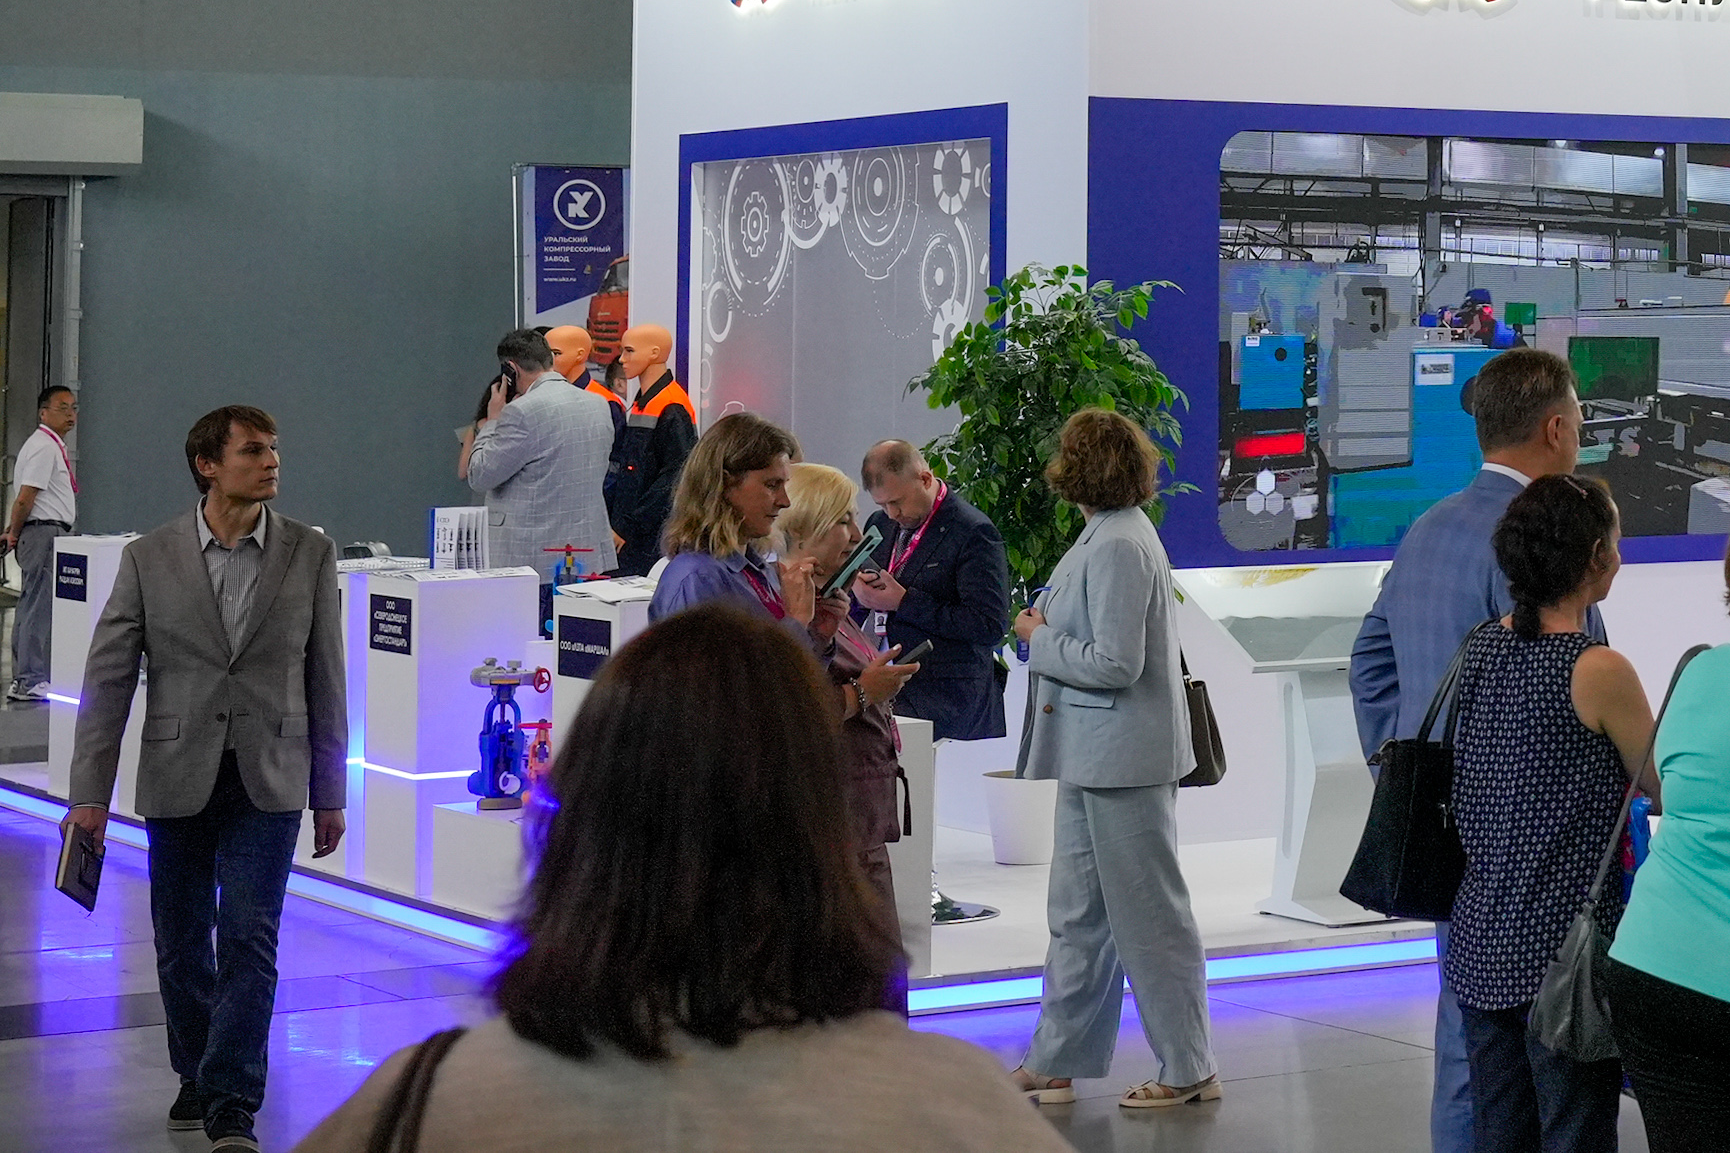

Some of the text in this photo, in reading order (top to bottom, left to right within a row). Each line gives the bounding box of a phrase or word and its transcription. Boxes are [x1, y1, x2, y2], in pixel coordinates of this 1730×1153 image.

[543, 235, 588, 243] УРАЛЬСКИЙ
[543, 245, 611, 253] КОМПРЕССОРНЫЙ
[543, 255, 570, 263] ЗАВОД
